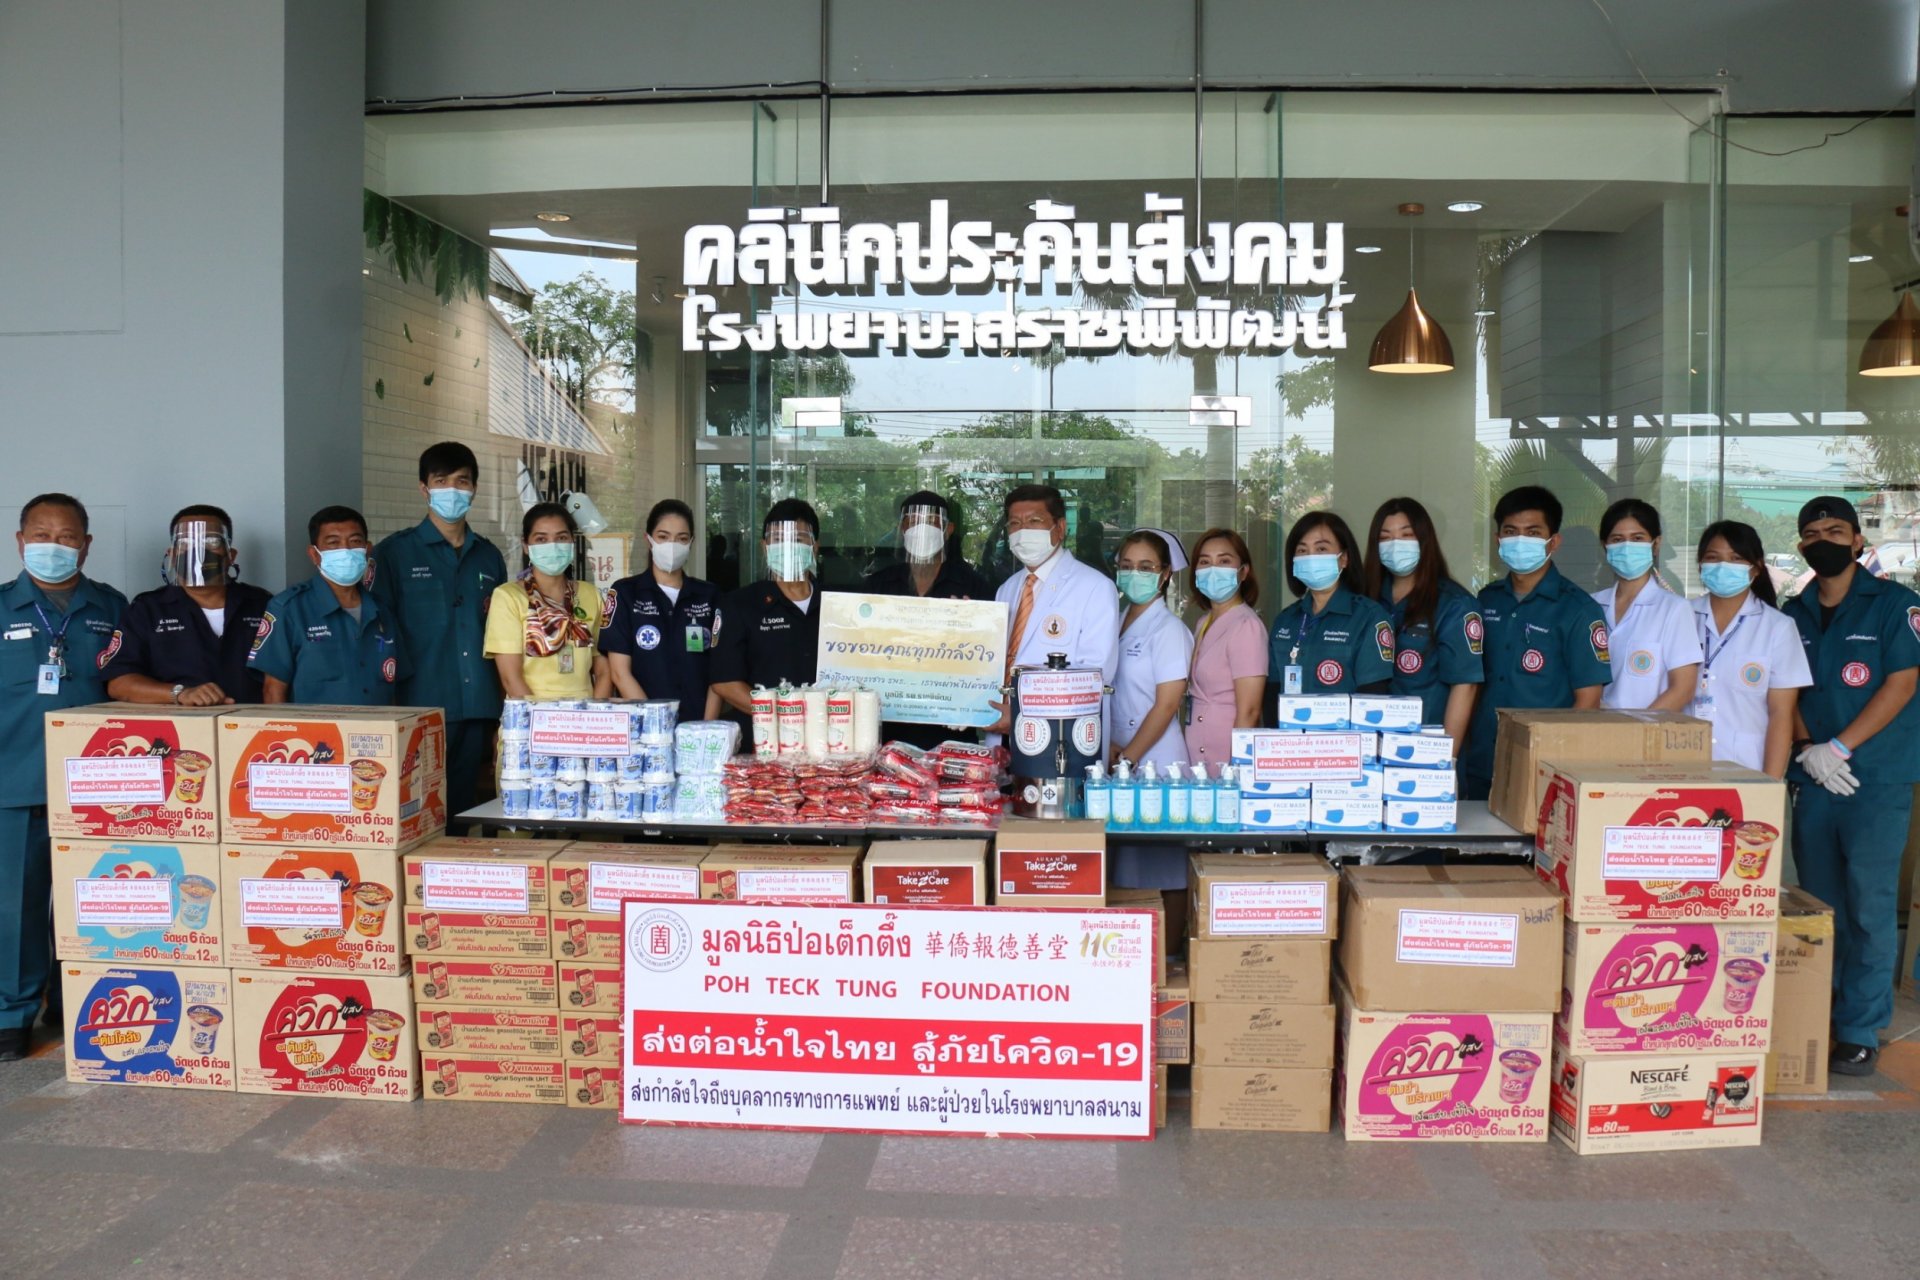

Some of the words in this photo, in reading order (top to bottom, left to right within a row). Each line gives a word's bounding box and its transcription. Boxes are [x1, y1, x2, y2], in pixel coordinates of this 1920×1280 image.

[683, 192, 1344, 287] คลินิกประกันสังคม
[703, 912, 911, 966] มูลนิธิป่อเต็กตึ๊ง
[704, 975, 749, 993] POH
[766, 977, 820, 996] TECK
[836, 979, 897, 998] TUNG
[921, 982, 1070, 1002] FOUNDATION
[642, 1018, 896, 1061] ส่งต่อน้ำใจไทย
[912, 1031, 1138, 1074] สู้ภัยโควิด-19
[1630, 1064, 1689, 1084] NESCAFÉ
[631, 1078, 900, 1116] ส่งกำลังใจถึงบุคลากรทางการแพทย์
[908, 1087, 1141, 1123] และผู้ป่วยในโรงพยาบาลสนาม
